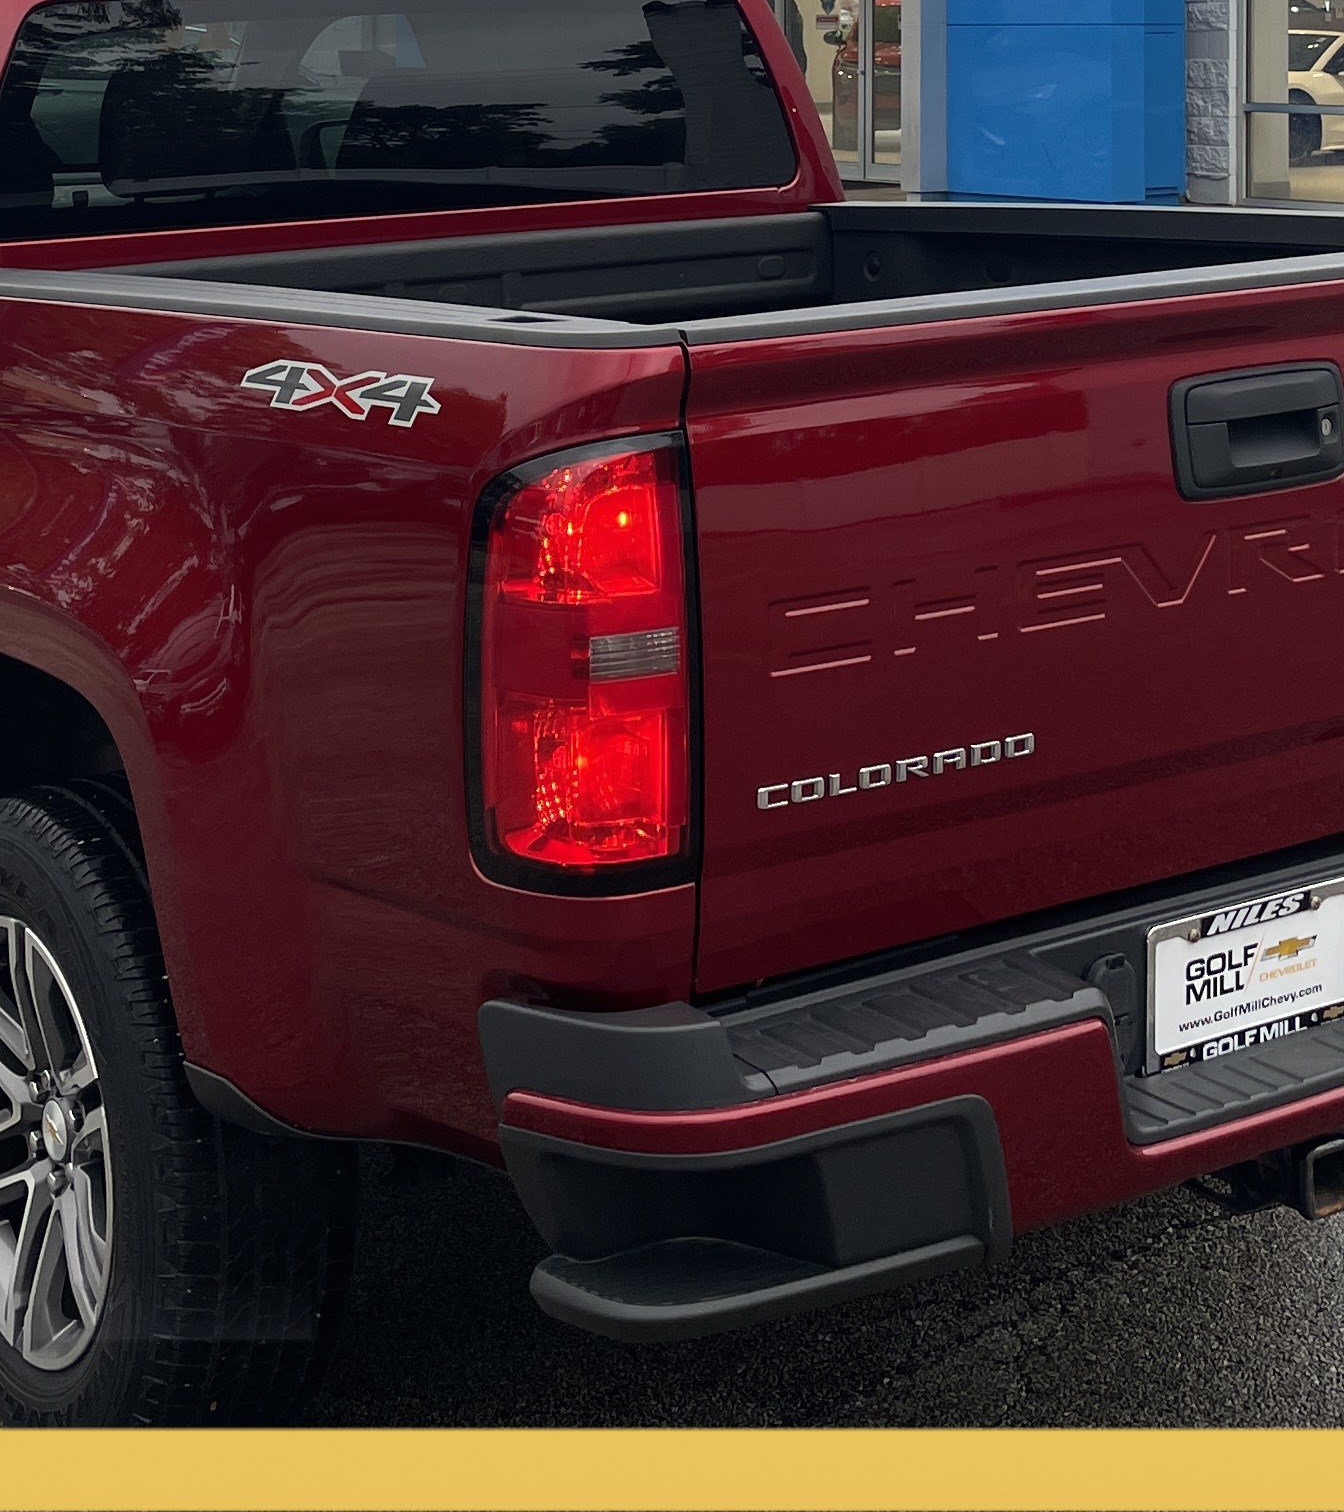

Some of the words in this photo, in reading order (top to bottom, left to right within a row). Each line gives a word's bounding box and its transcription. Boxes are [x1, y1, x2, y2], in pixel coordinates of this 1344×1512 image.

[757, 732, 1035, 810] COLORADO
[1206, 891, 1305, 937] NILES
[1185, 942, 1258, 982] GOLF
[1259, 958, 1318, 983] CHEVROLET
[1178, 983, 1323, 1033] www.GolfMillChevy.com
[1185, 970, 1245, 1005] MILL
[1202, 1032, 1256, 1061] GOLF
[1259, 1015, 1309, 1043] MILL
